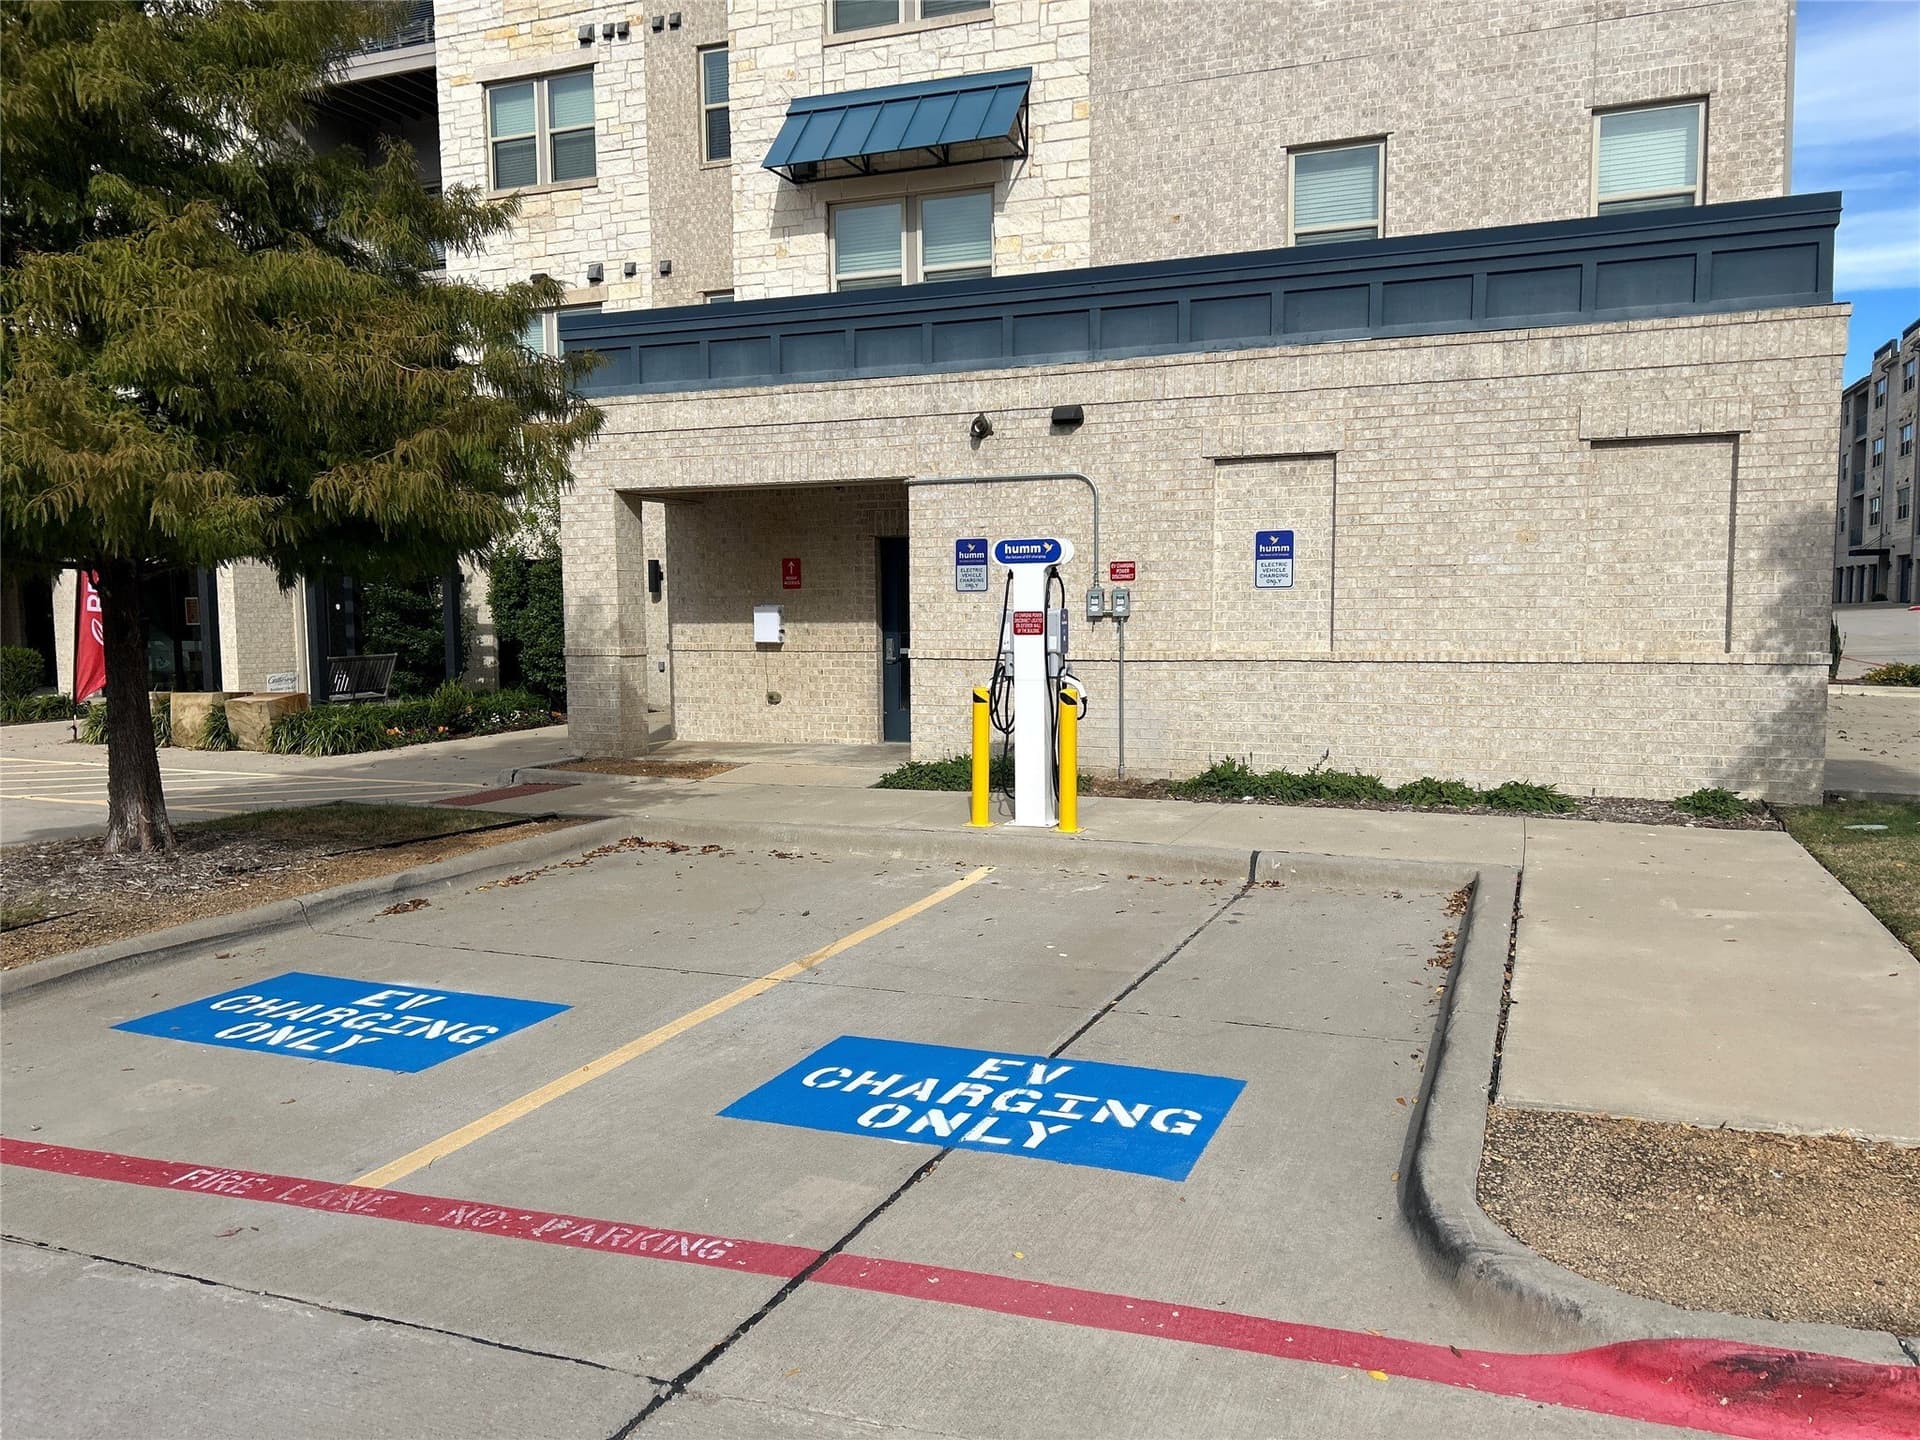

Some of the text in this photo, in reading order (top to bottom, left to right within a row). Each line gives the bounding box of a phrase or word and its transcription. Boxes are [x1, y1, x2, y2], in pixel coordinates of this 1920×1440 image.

[959, 551, 985, 559] humm
[1004, 543, 1041, 554] humm
[1259, 544, 1290, 553] humm
[354, 989, 446, 1010] EV
[209, 994, 500, 1045] CHARGING
[214, 1021, 382, 1055] ONLY
[968, 1057, 1075, 1085] EV
[801, 1066, 1204, 1137] CHARGING
[856, 1102, 1073, 1150] ONLY
[169, 1168, 734, 1260] FIRE LANE NO PARKING
